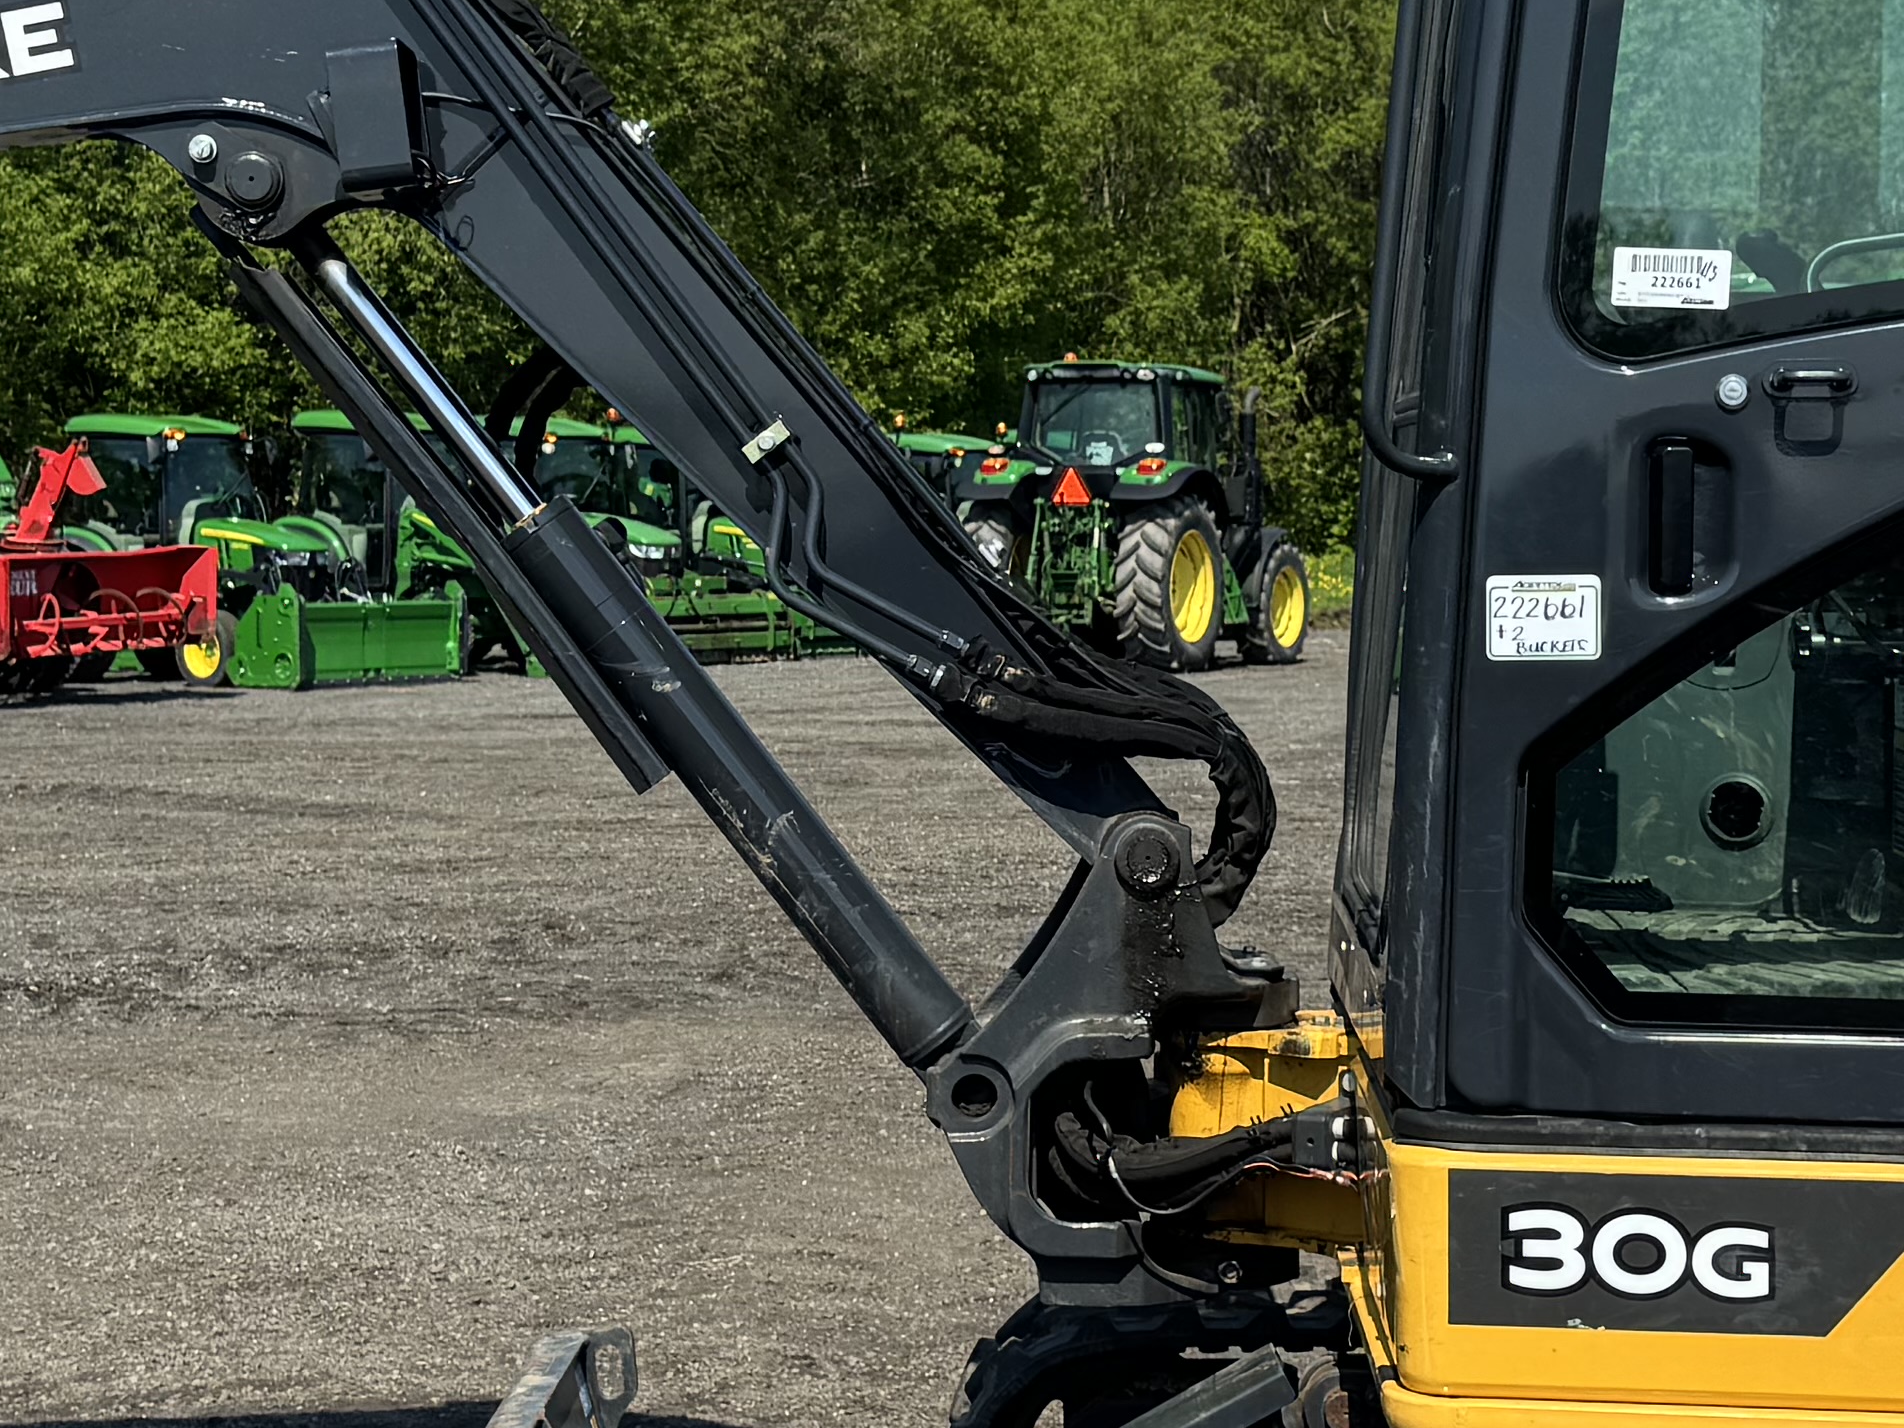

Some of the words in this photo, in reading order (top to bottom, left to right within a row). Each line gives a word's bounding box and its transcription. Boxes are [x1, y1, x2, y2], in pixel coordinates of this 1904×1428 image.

[1651, 275, 1701, 289] 222661
[1493, 594, 1586, 621] 222661
[1511, 625, 1525, 641] 2
[1506, 1206, 1772, 1301] 30G
